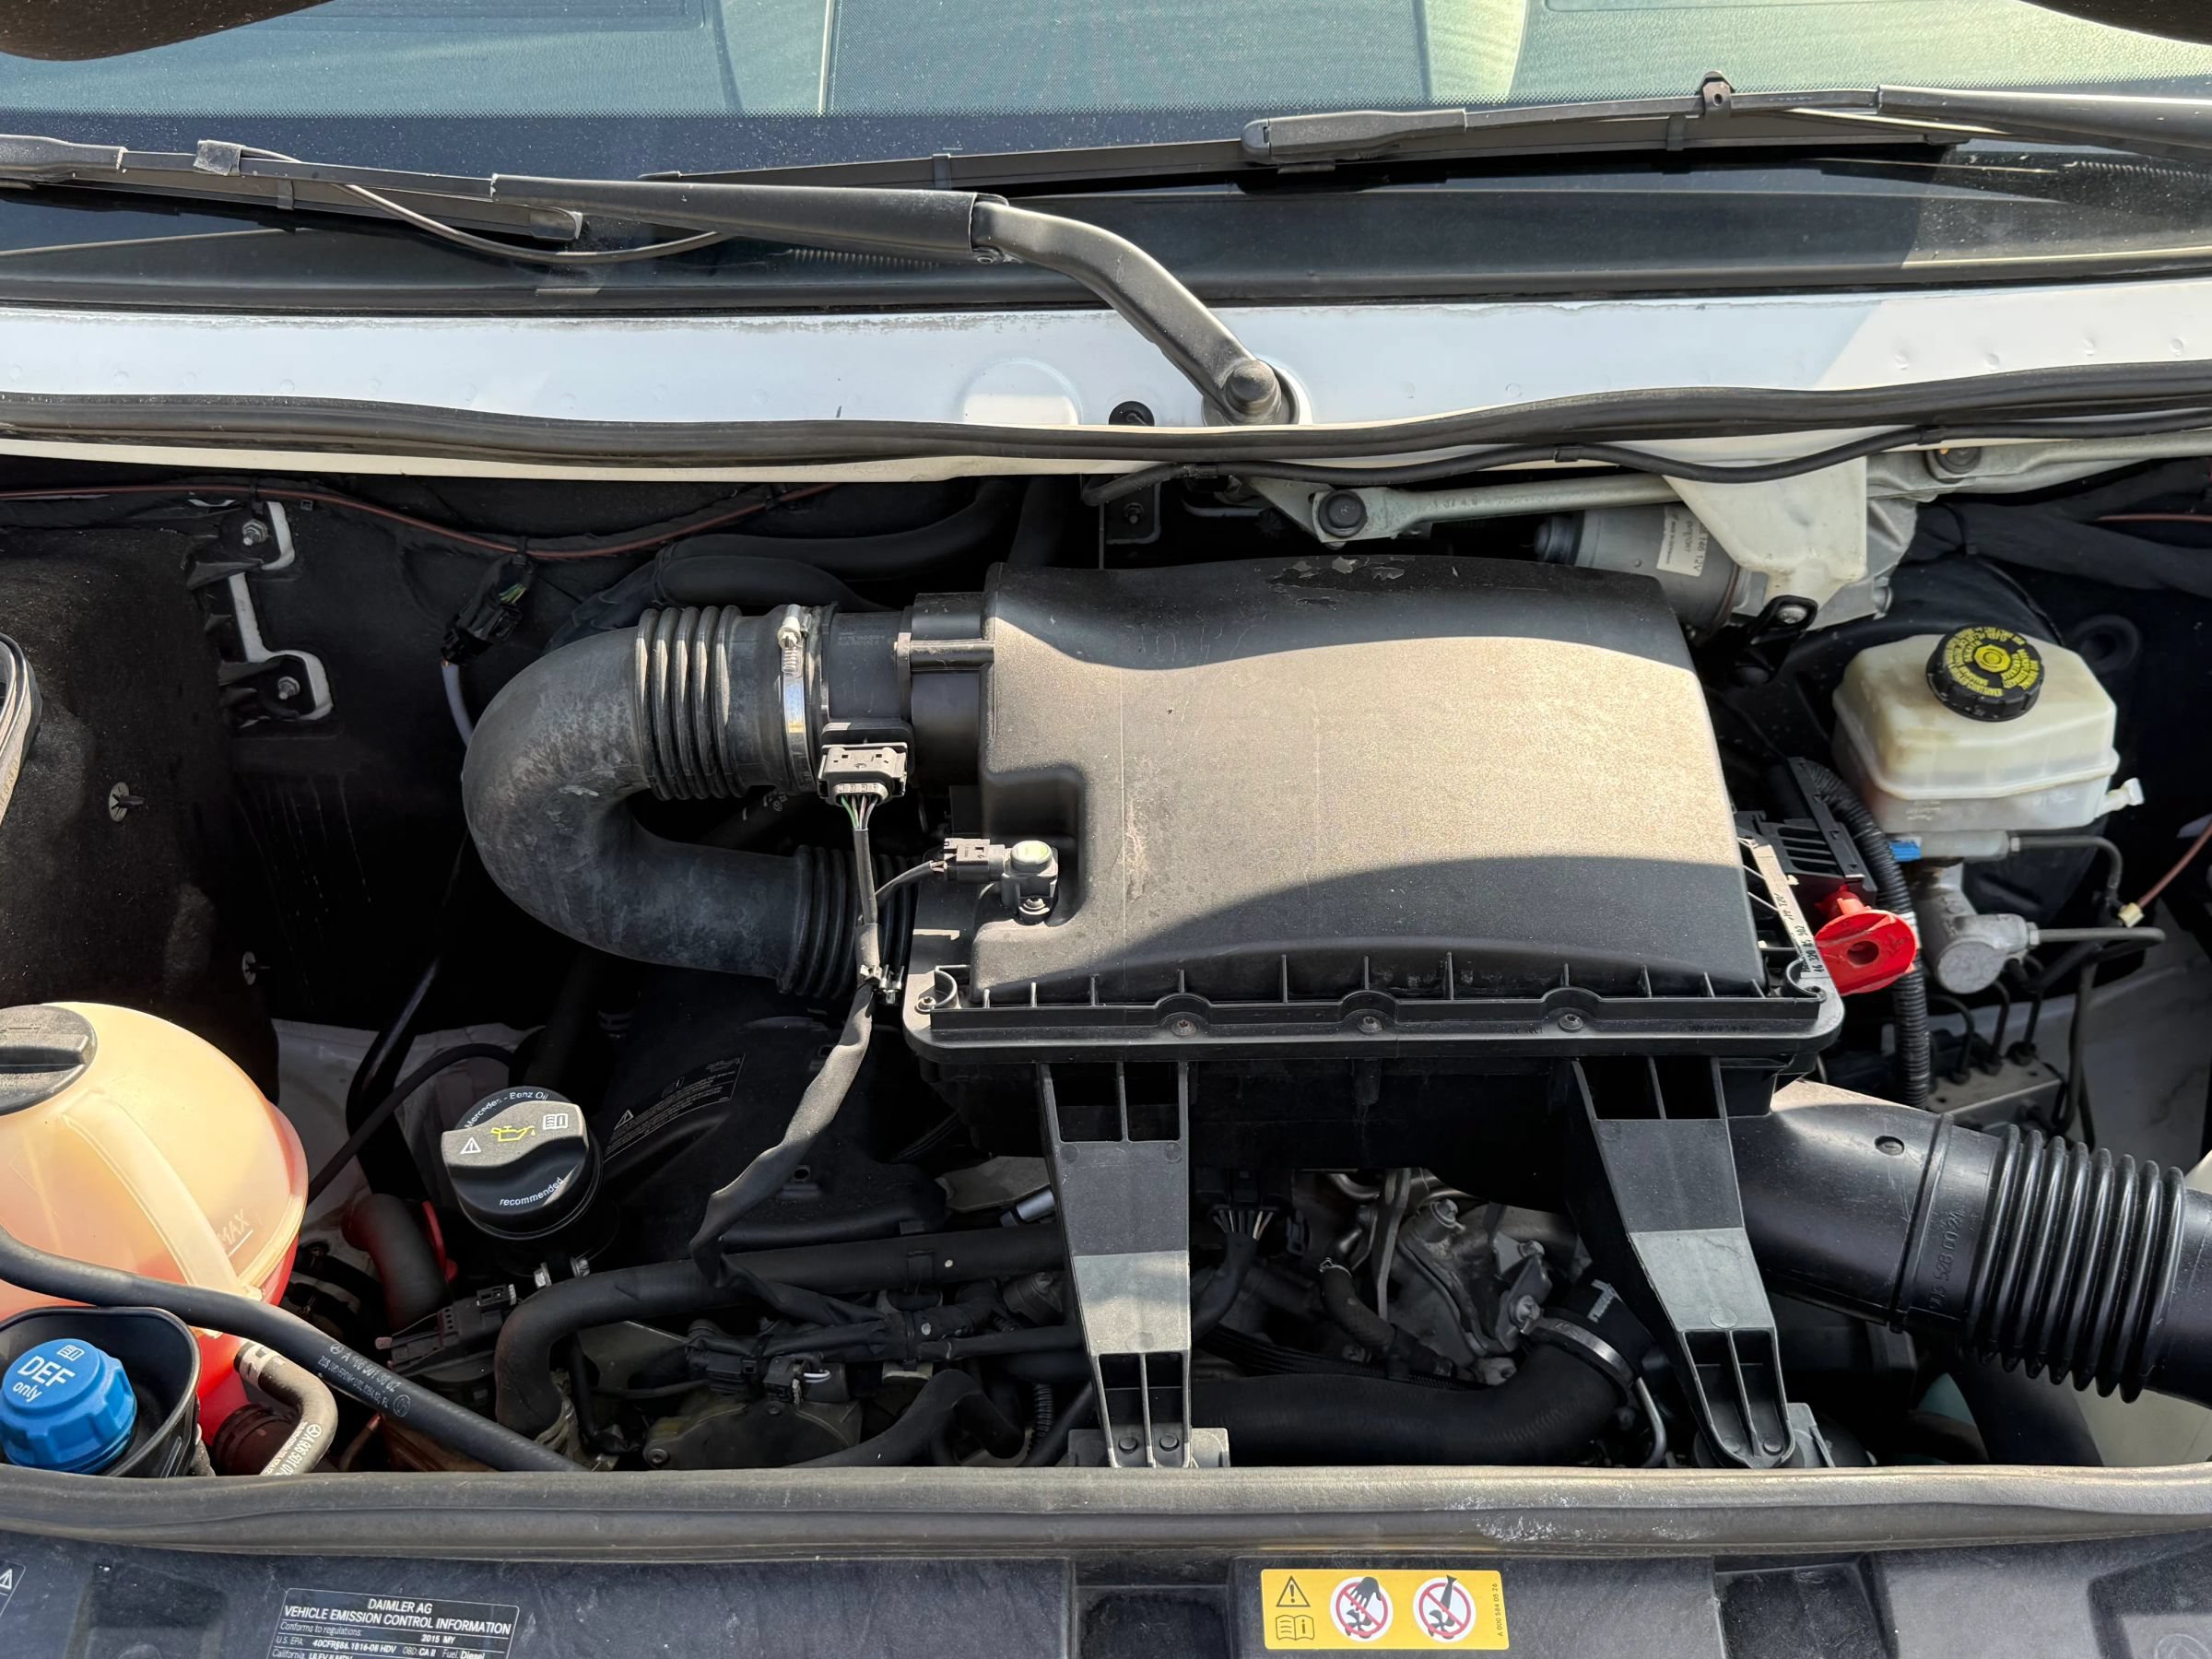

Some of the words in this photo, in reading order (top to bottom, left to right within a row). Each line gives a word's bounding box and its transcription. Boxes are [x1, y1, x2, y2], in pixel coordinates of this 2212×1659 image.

[535, 1091, 549, 1100] Oil
[499, 1177, 563, 1206] recommended
[218, 1208, 250, 1244] MAX
[17, 1355, 76, 1387] DEF
[341, 1352, 351, 1362] A
[362, 1364, 381, 1379] 501
[12, 1381, 42, 1403] only
[295, 1438, 312, 1454] 906
[367, 1598, 414, 1613] DAIMLER
[416, 1603, 433, 1614] AG
[280, 1621, 313, 1632] Conforms
[314, 1624, 323, 1633] to
[284, 1605, 328, 1619] VEHICLE
[329, 1608, 382, 1625] EMISSION
[383, 1613, 434, 1629] CONTROL
[435, 1618, 512, 1634] INFORMATION
[421, 1633, 440, 1643] 2015
[442, 1636, 455, 1644] MY
[380, 1643, 396, 1653] HDV
[418, 1647, 429, 1656] CA
[460, 1650, 486, 1659] Diesel
